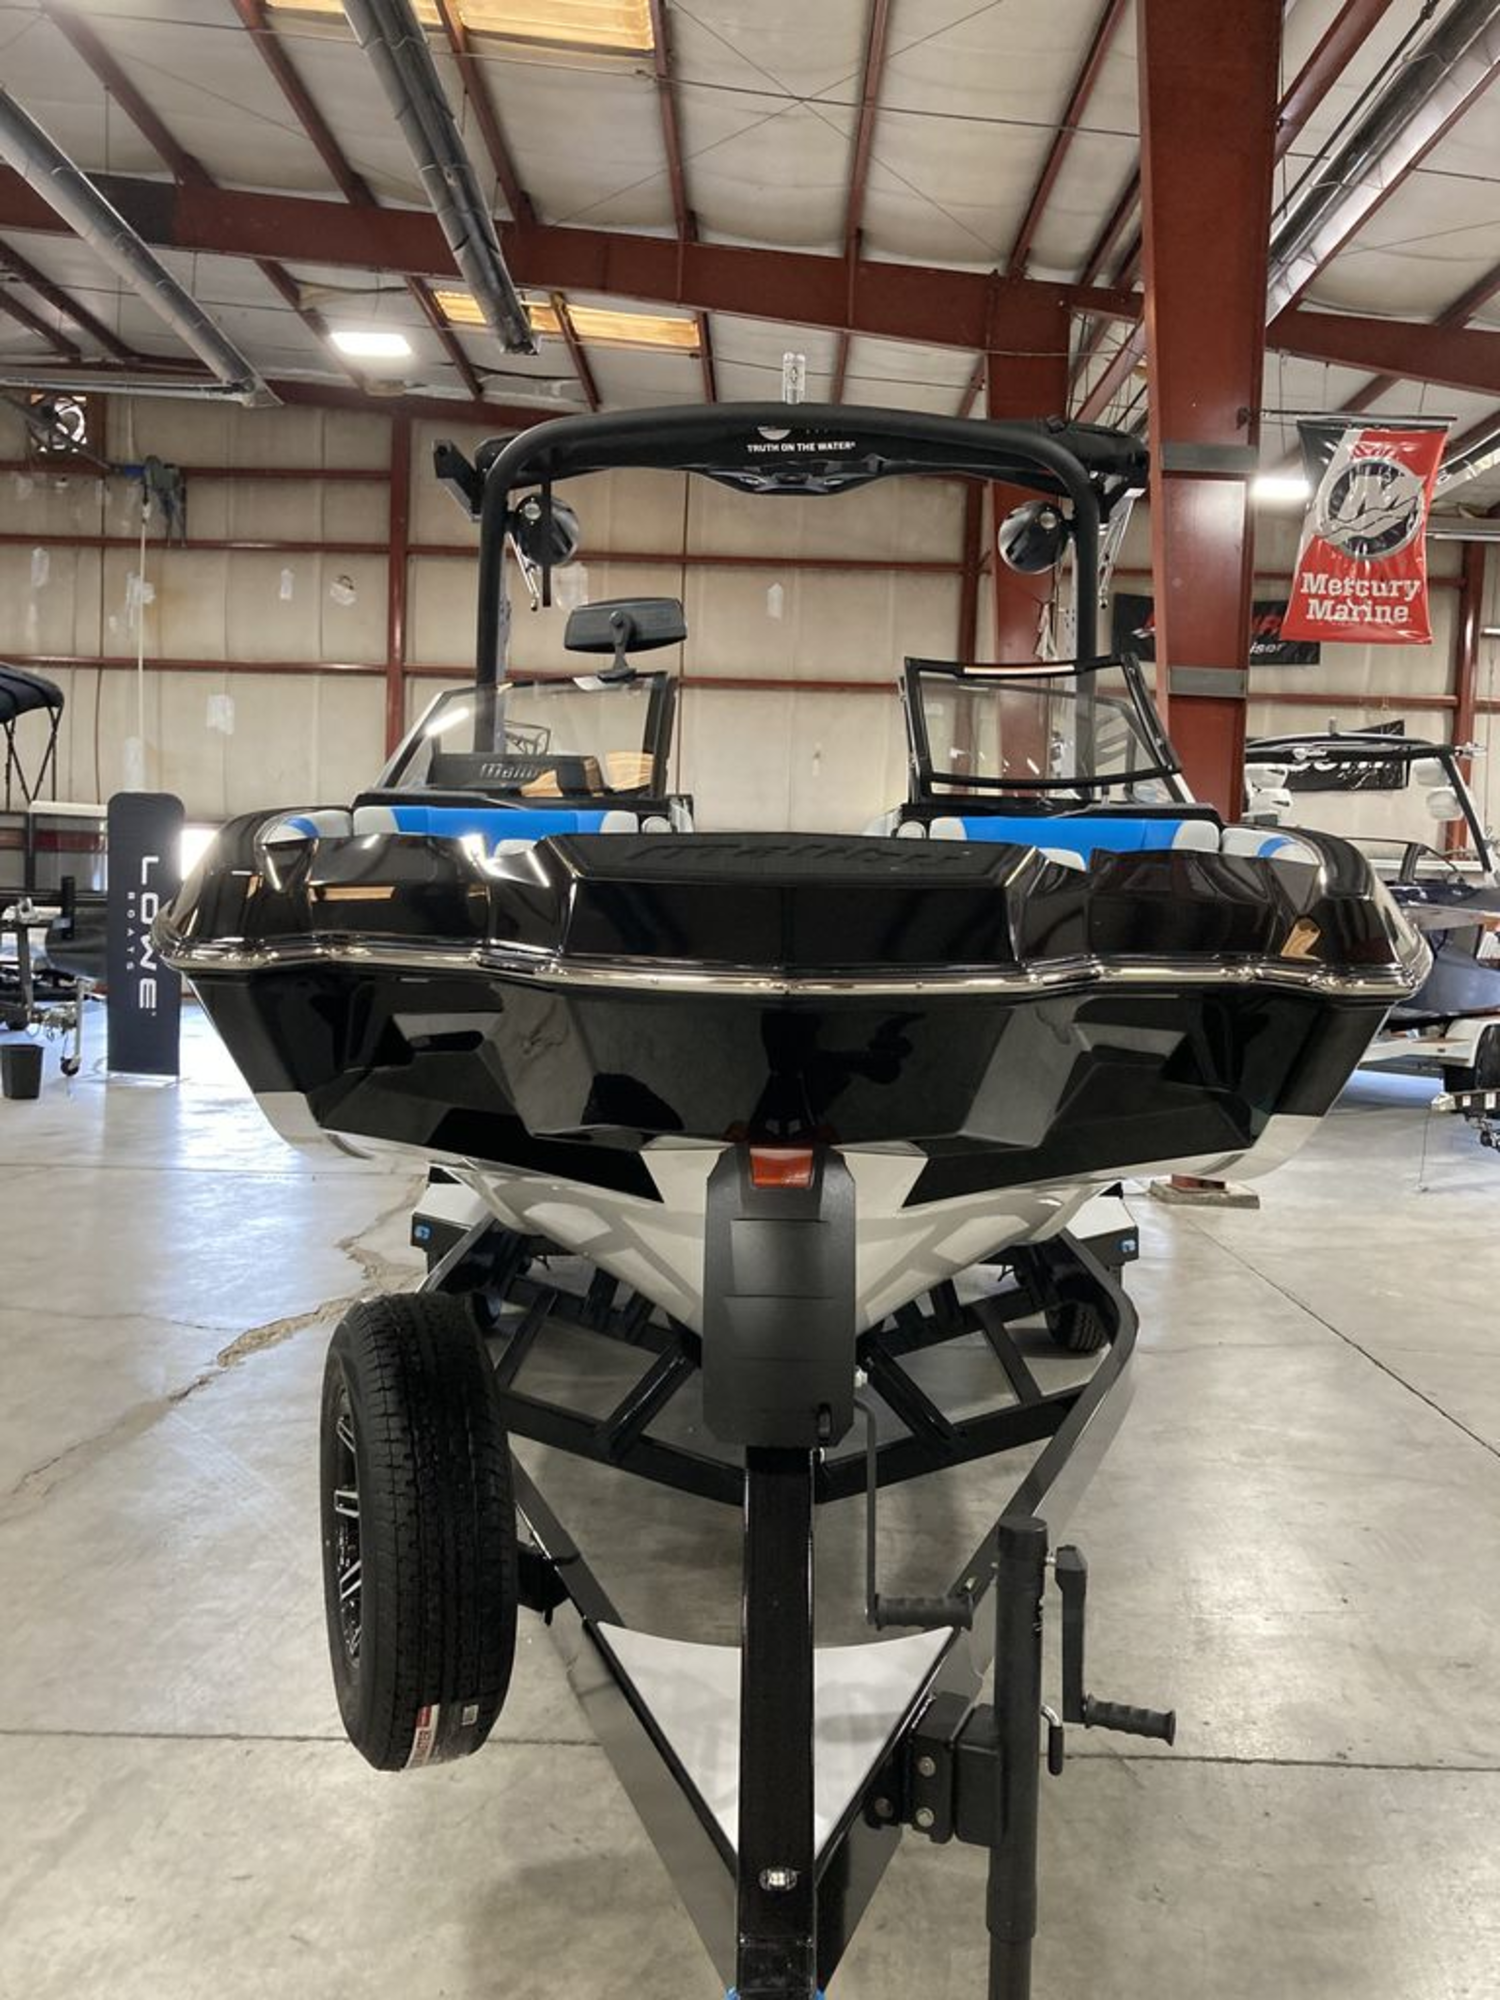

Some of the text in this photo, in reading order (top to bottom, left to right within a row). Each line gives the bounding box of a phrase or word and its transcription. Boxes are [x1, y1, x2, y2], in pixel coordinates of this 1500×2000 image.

[747, 443, 779, 453] TRUTH
[781, 442, 795, 452] ON
[797, 441, 816, 451] THE
[1300, 572, 1421, 601] Mercury
[1306, 598, 1409, 623] Marine
[126, 891, 136, 970] BOATS
[139, 856, 160, 1009] LOWE
